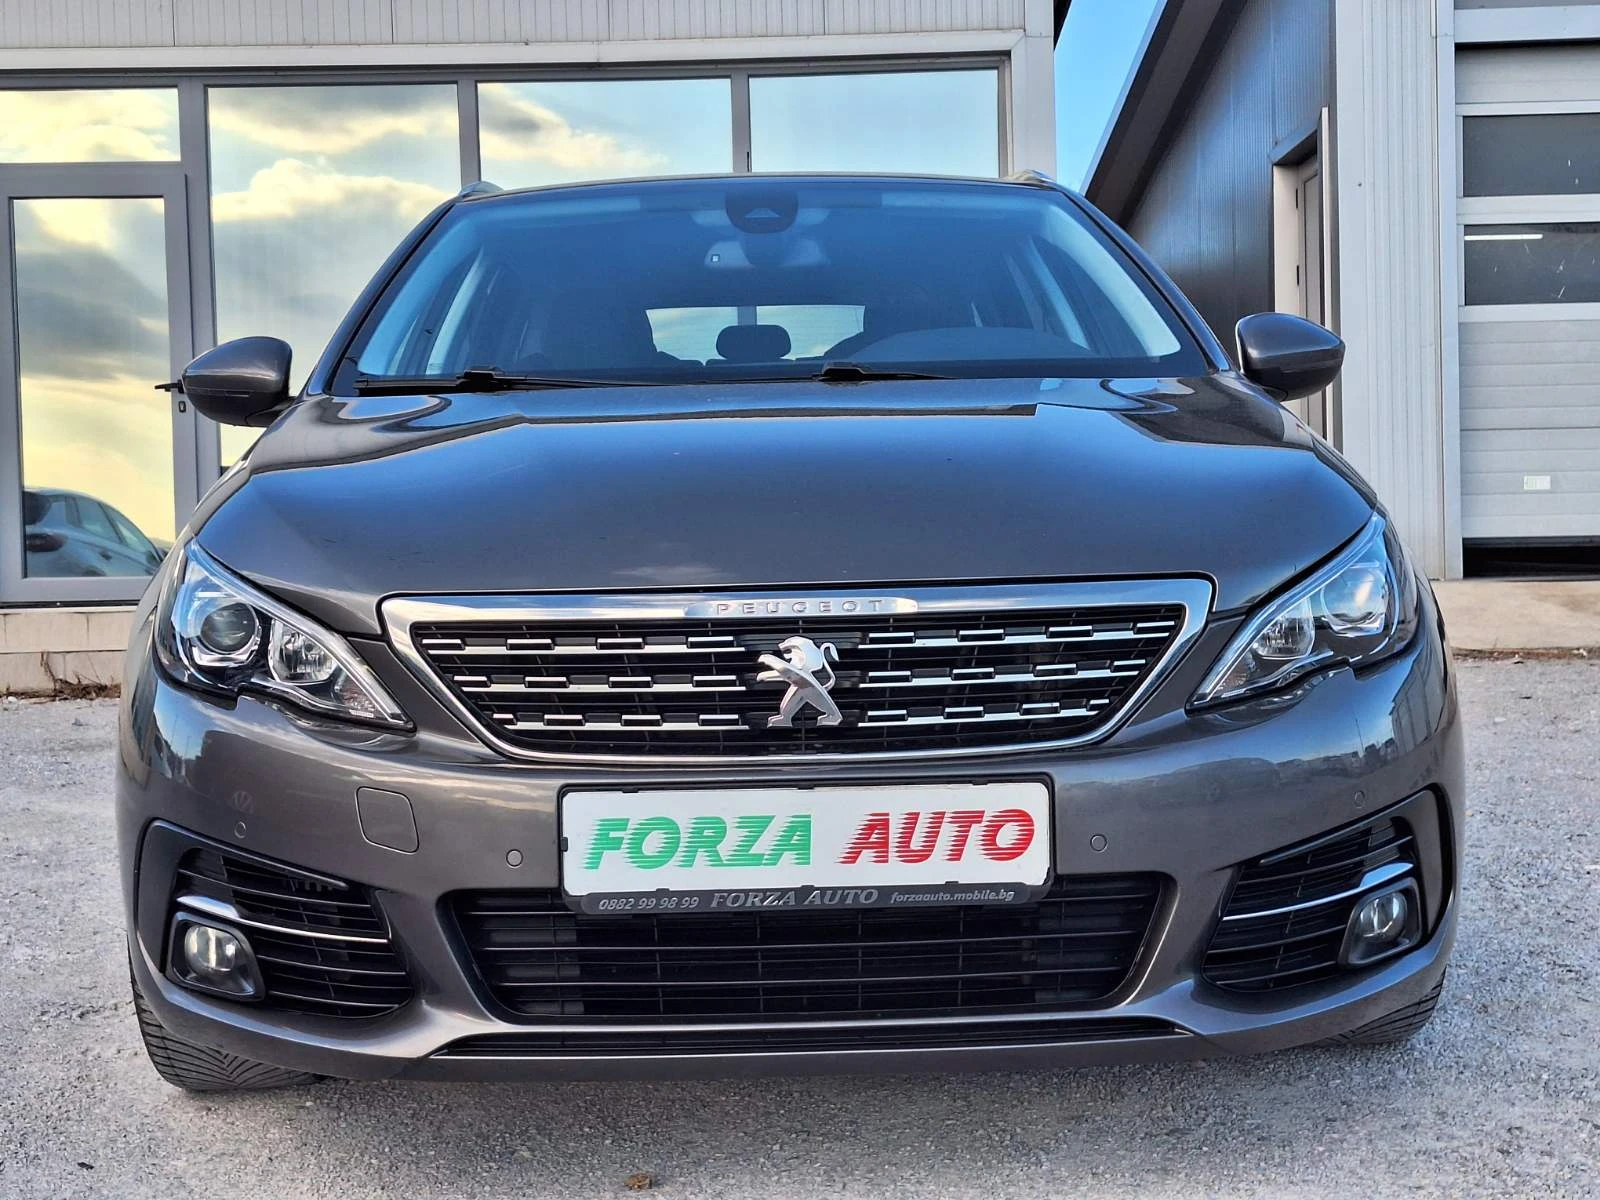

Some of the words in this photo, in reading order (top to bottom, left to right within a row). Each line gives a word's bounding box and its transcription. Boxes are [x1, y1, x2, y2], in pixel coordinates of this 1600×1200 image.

[716, 599, 884, 615] PEUGEOT
[583, 813, 812, 870] FORZA
[837, 808, 1036, 865] AUTO
[598, 898, 635, 911] 0882
[637, 897, 658, 910] 99
[659, 896, 678, 909] 98
[680, 896, 700, 909] 99
[711, 891, 796, 908] FORZA
[804, 889, 878, 905] AUTO
[890, 889, 1015, 904] forzaauto.mobile.bg
